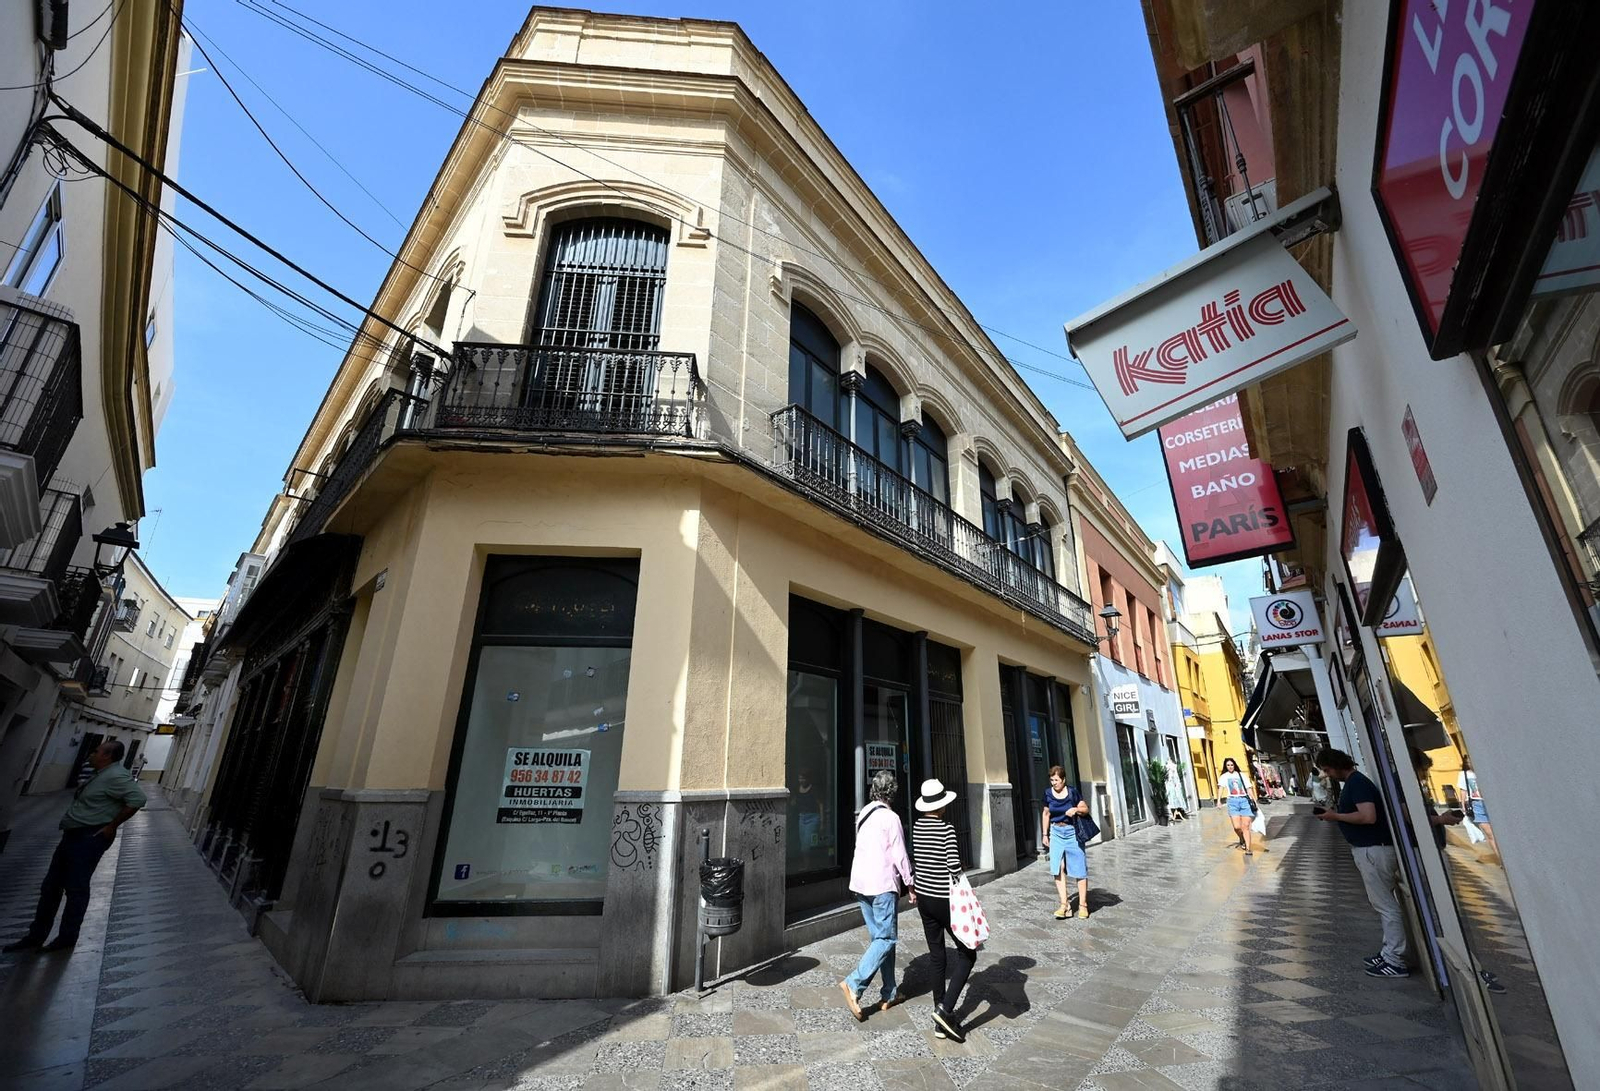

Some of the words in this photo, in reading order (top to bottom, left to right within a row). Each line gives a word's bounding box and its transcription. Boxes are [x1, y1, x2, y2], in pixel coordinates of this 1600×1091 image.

[1439, 0, 1512, 200] COR
[1113, 279, 1306, 396] katia
[1178, 443, 1250, 474] MEDIAS
[1190, 473, 1256, 499] BAÑO
[1190, 504, 1279, 542] PARÍS
[1262, 632, 1292, 642] LANAS
[1113, 691, 1137, 700] NICE
[1115, 703, 1139, 713] GIRL
[514, 751, 530, 766] SE
[531, 752, 582, 767] ALQUILA
[510, 769, 533, 783] 956
[534, 769, 549, 783] 34
[551, 770, 565, 784] 87
[567, 770, 582, 784] 42
[513, 787, 572, 797] HUERTAS
[509, 798, 573, 806] INMOBILIARIA
